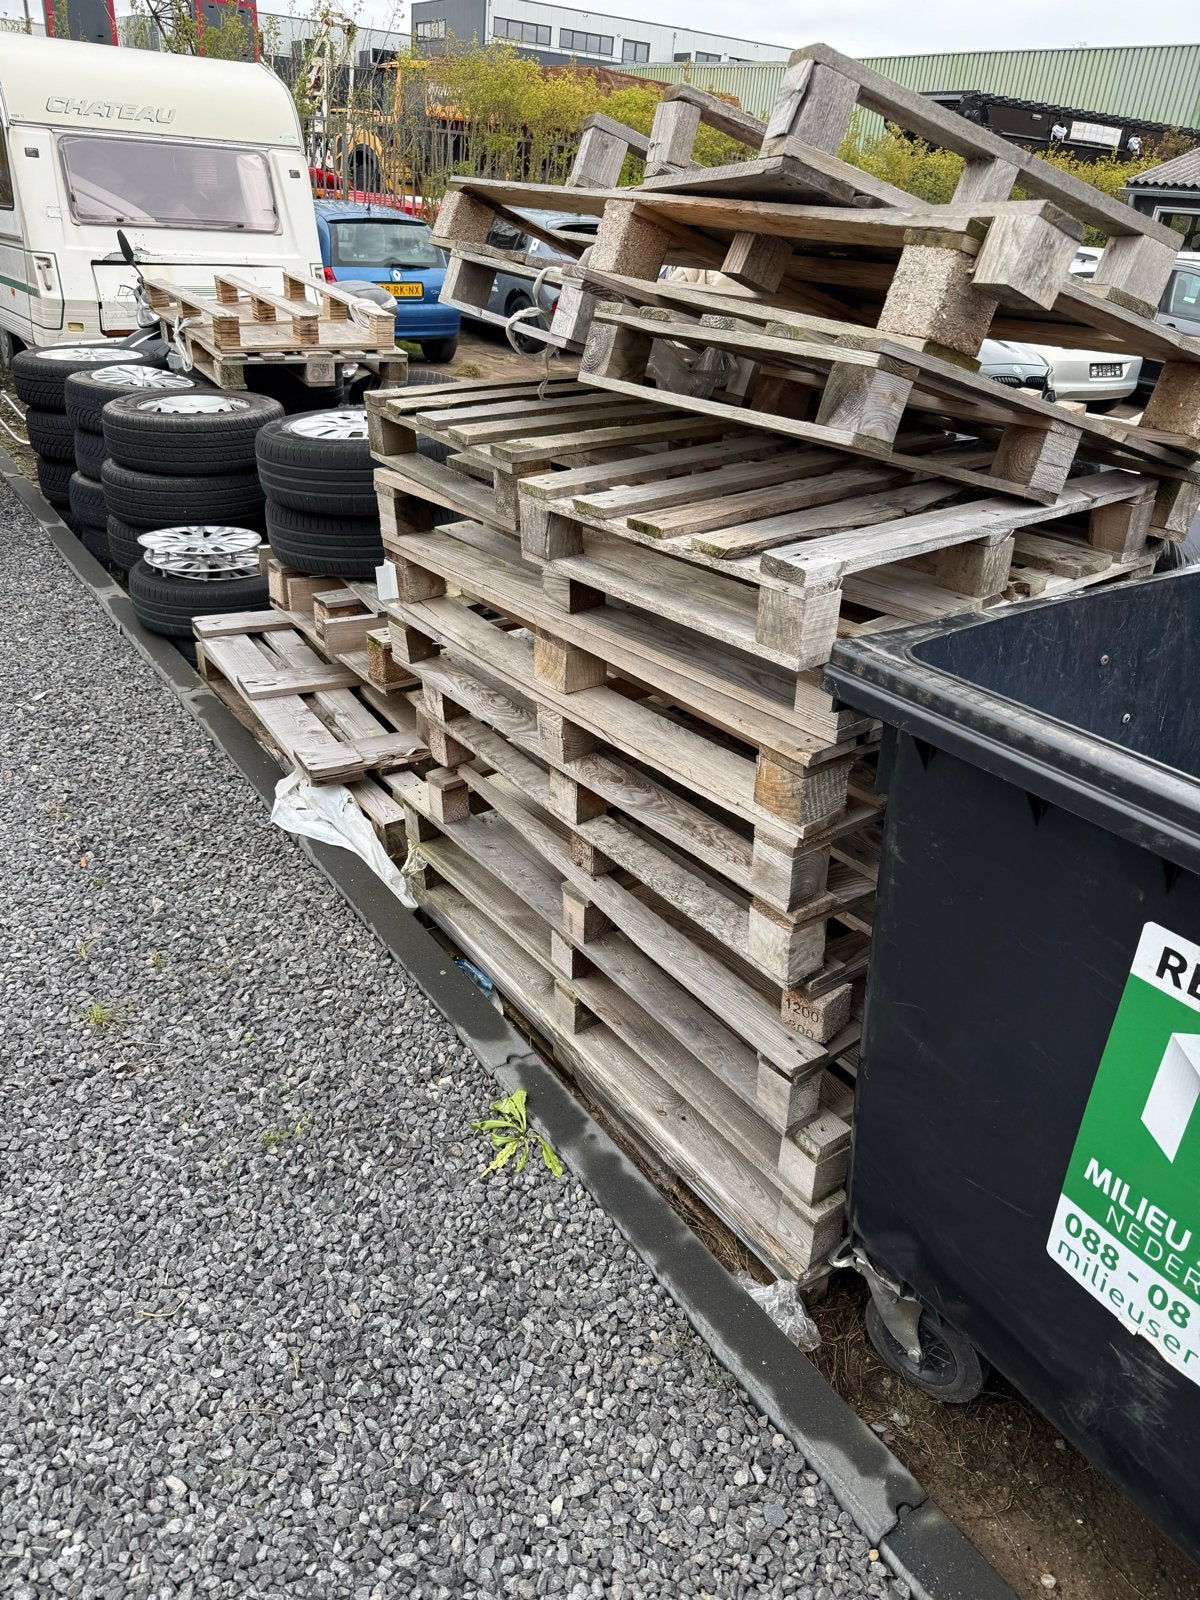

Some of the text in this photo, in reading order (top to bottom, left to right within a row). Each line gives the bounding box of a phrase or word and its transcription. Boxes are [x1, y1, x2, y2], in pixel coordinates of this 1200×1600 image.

[45, 95, 177, 124] CHATEAU
[380, 285, 421, 295] 8-RK-NX
[785, 998, 819, 1022] 1200
[1083, 1157, 1193, 1252] MILIEU
[1065, 1212, 1120, 1272] 088
[1147, 1283, 1191, 1329] 08
[1105, 1205, 1200, 1295] NEDER
[1057, 1240, 1199, 1363] milieuser
